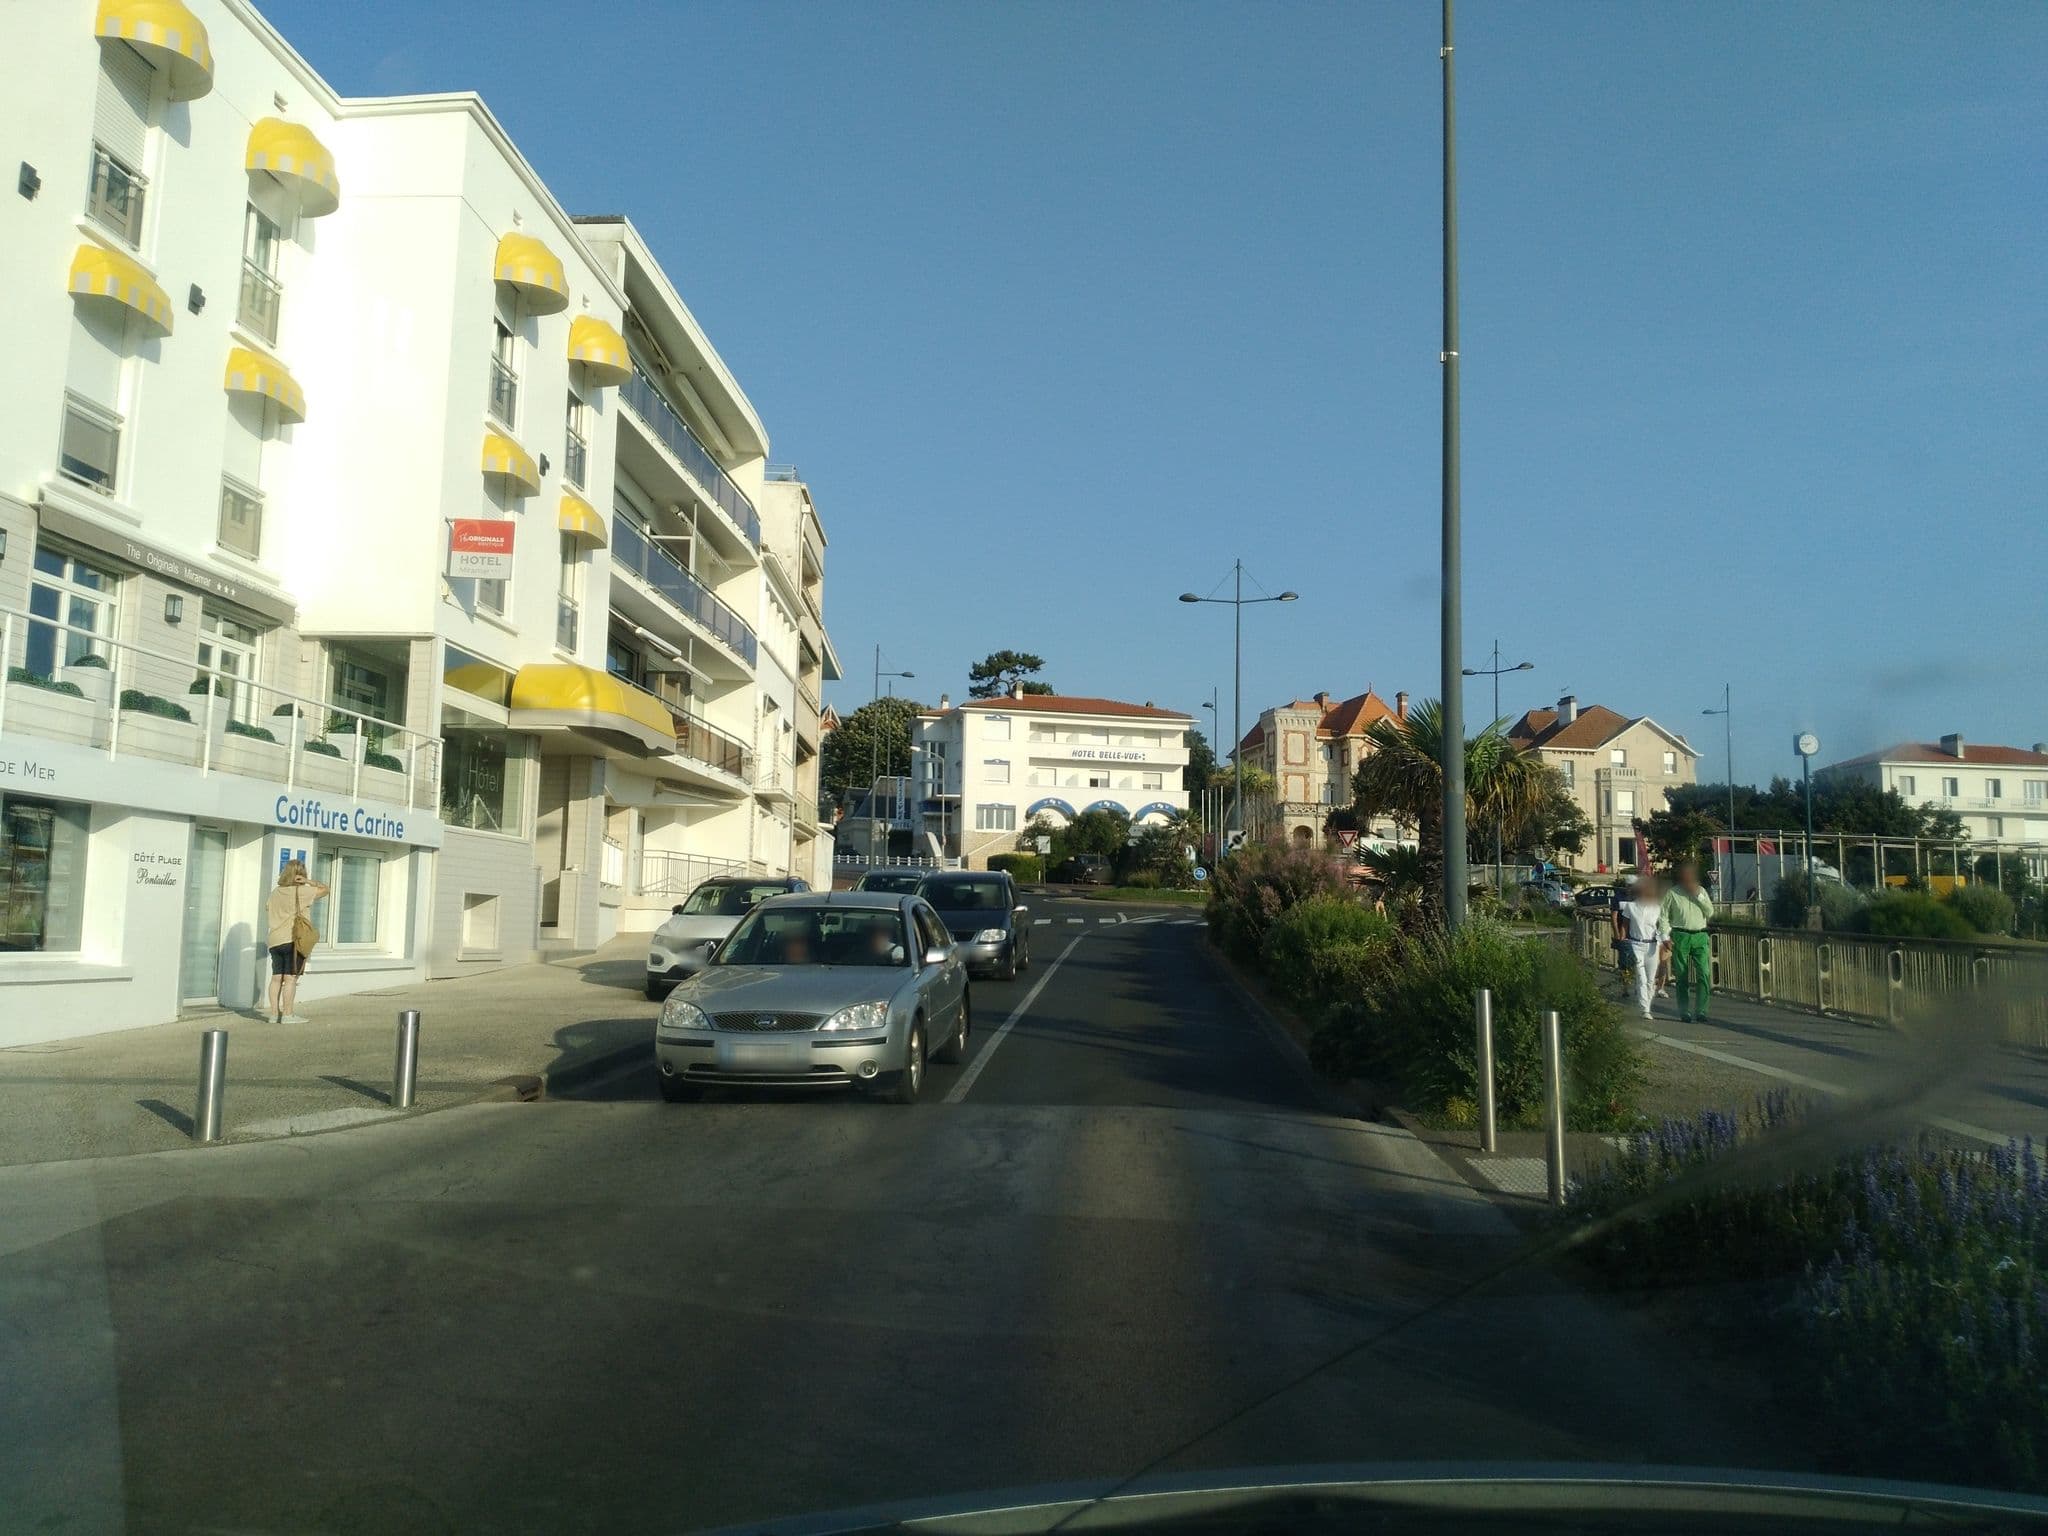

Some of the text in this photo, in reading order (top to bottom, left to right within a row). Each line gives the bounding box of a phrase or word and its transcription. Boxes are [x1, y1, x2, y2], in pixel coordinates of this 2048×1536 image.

[126, 543, 141, 560] The
[146, 552, 180, 575] Originals
[184, 567, 212, 587] Miramar
[460, 555, 502, 566] HOTEL
[1072, 750, 1096, 758] HOTEL
[276, 795, 404, 839] Coiffure Carine
